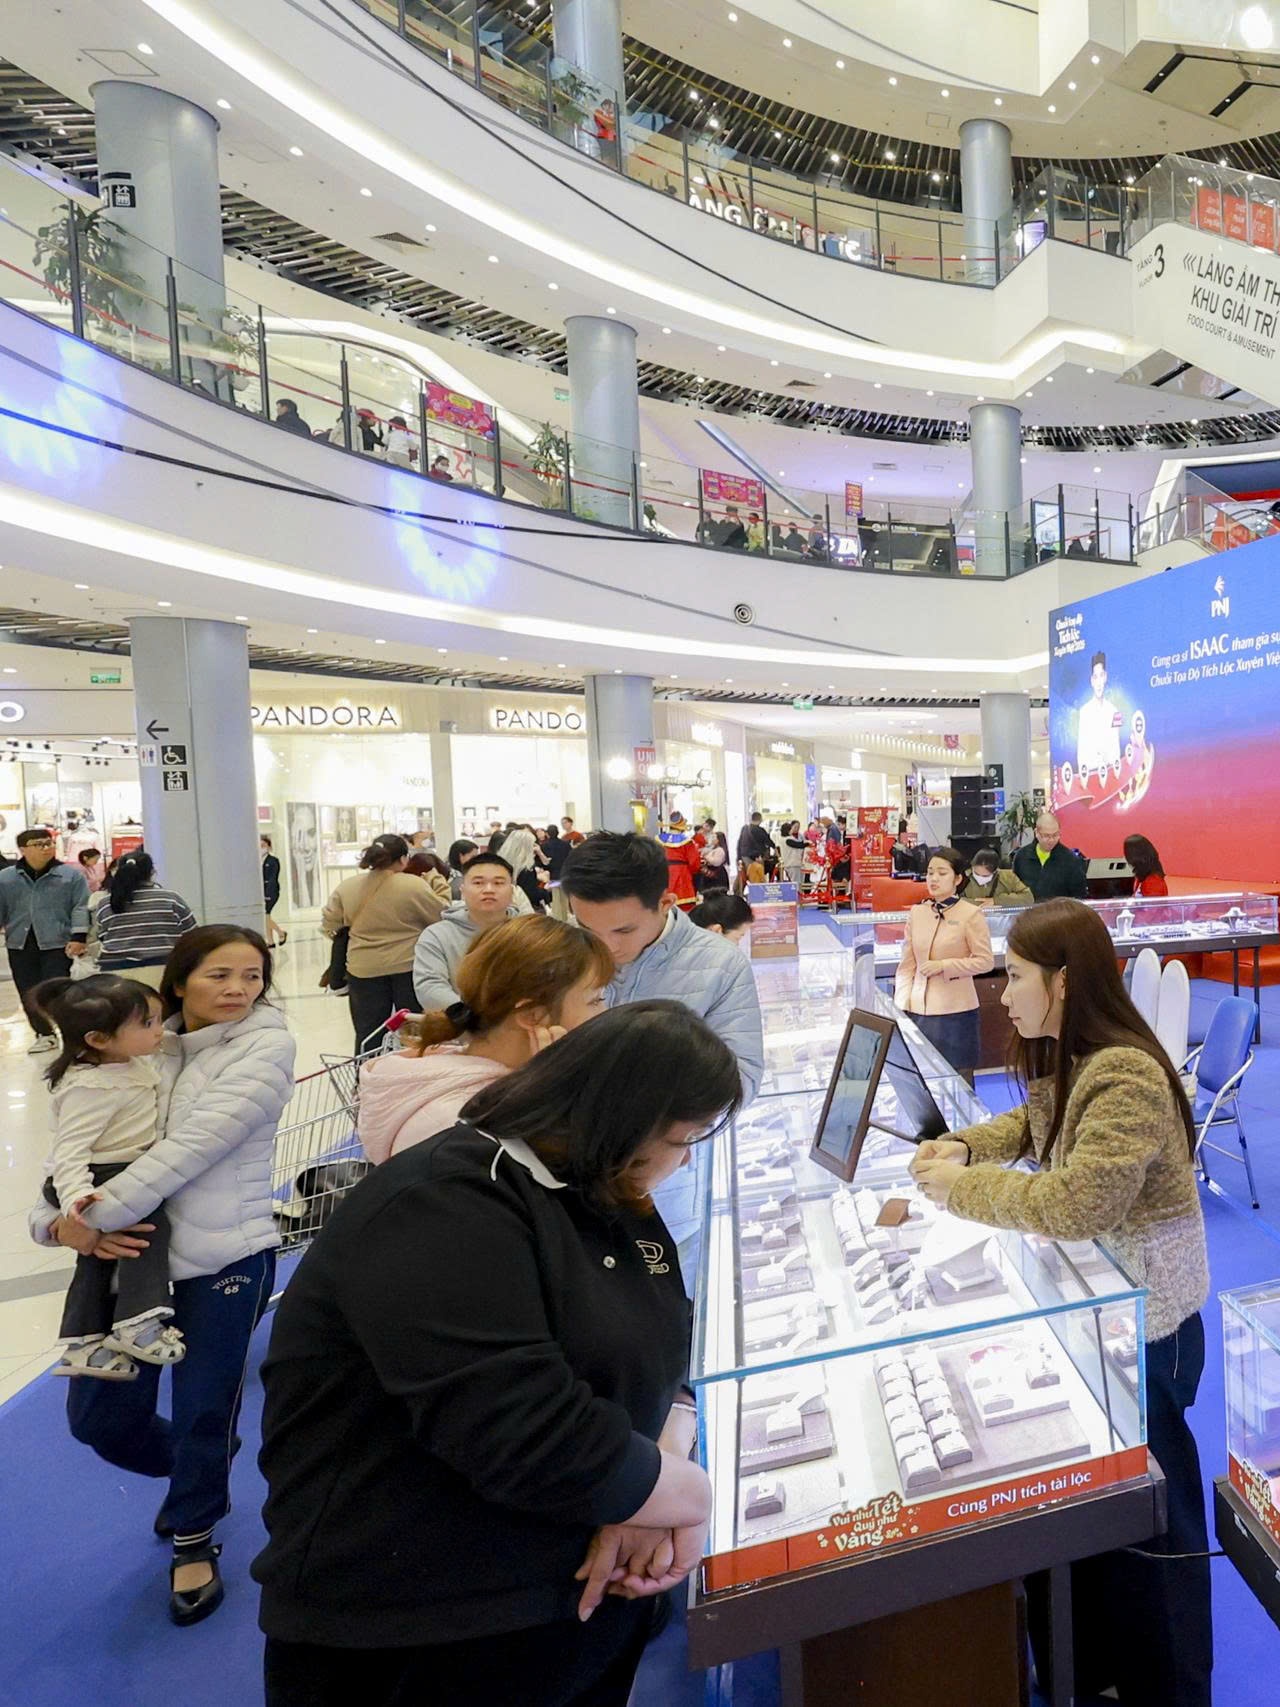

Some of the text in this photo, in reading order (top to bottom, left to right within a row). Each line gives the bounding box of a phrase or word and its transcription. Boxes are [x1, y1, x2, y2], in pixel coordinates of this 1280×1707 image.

[1154, 243, 1165, 278] 3
[1197, 253, 1233, 288] LÀNG
[1191, 285, 1278, 339] KHU GIẢI TRÍ
[1187, 313, 1276, 360] FOOD COURT & AMUSEMENT
[1210, 597, 1230, 619] PNJ
[1171, 655, 1180, 665] ca
[1190, 634, 1229, 660] ISAAC
[1231, 635, 1254, 652] tham
[1255, 634, 1269, 650] gia
[1150, 667, 1172, 688] Chuỗi
[1201, 662, 1218, 679] Tích
[1219, 660, 1235, 676] Lộc
[1235, 656, 1264, 675] Xuyên
[251, 706, 398, 726] PANDORA
[870, 1494, 900, 1517] Tết
[947, 1472, 1092, 1518] Cùng PNJ tích tài lộc
[834, 1529, 885, 1551] Vàng
